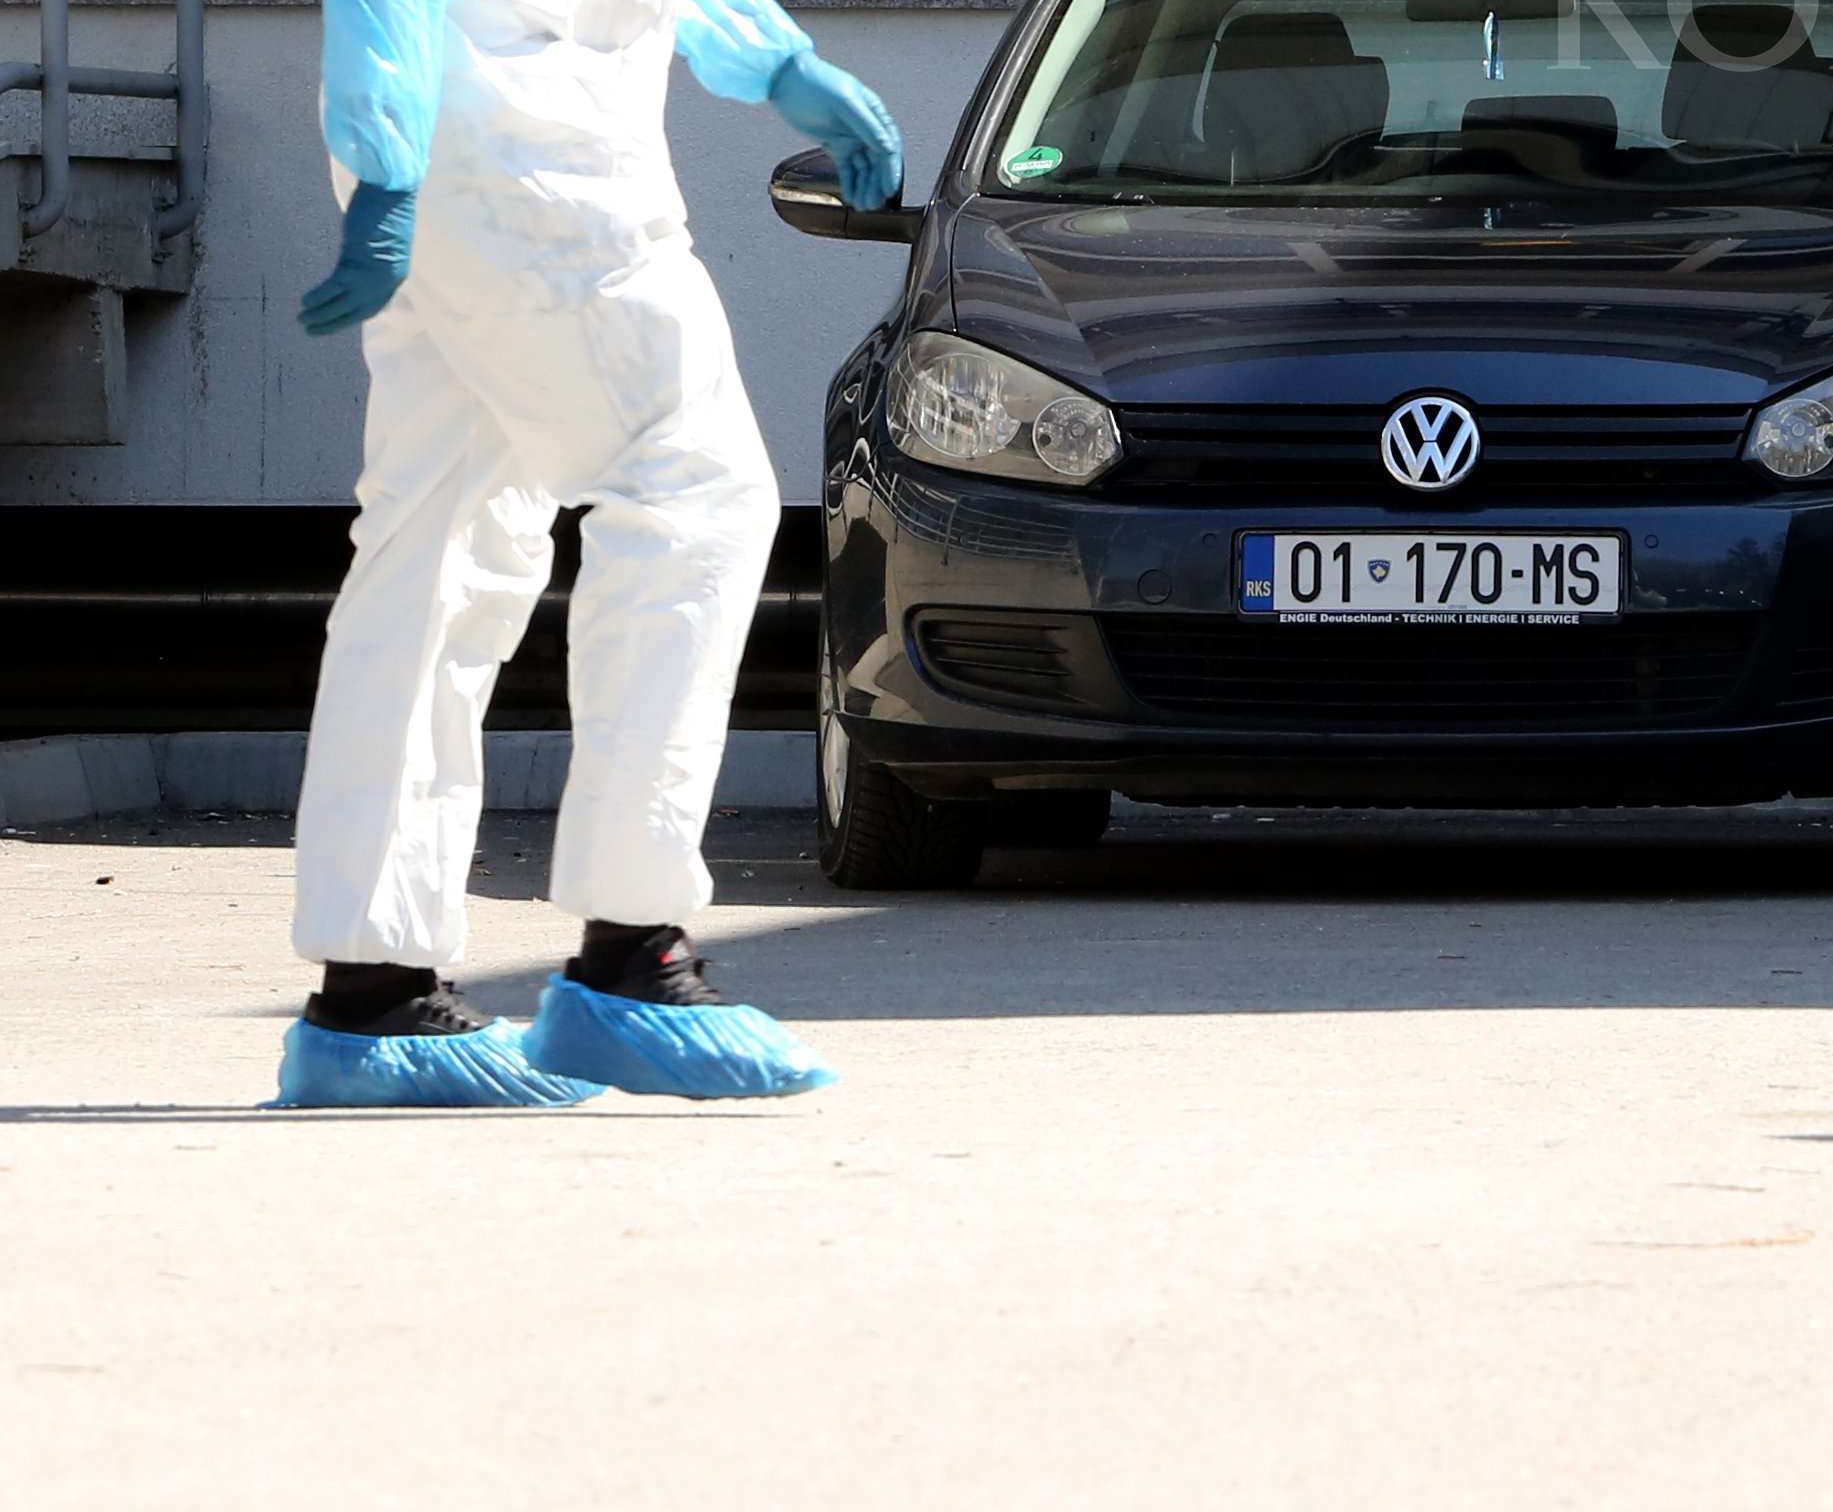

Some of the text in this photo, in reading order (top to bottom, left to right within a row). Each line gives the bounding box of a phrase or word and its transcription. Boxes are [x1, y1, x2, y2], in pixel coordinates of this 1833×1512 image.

[1383, 399, 1478, 486] VW
[1246, 580, 1271, 597] RKS
[1290, 540, 1600, 606] 01 170-MS
[1279, 613, 1317, 624] ENGIE
[1319, 613, 1392, 624] Deutschland
[1402, 613, 1457, 624] TECHNIK
[1465, 613, 1519, 624] ENERGIE
[1527, 614, 1580, 625] SERVICE
